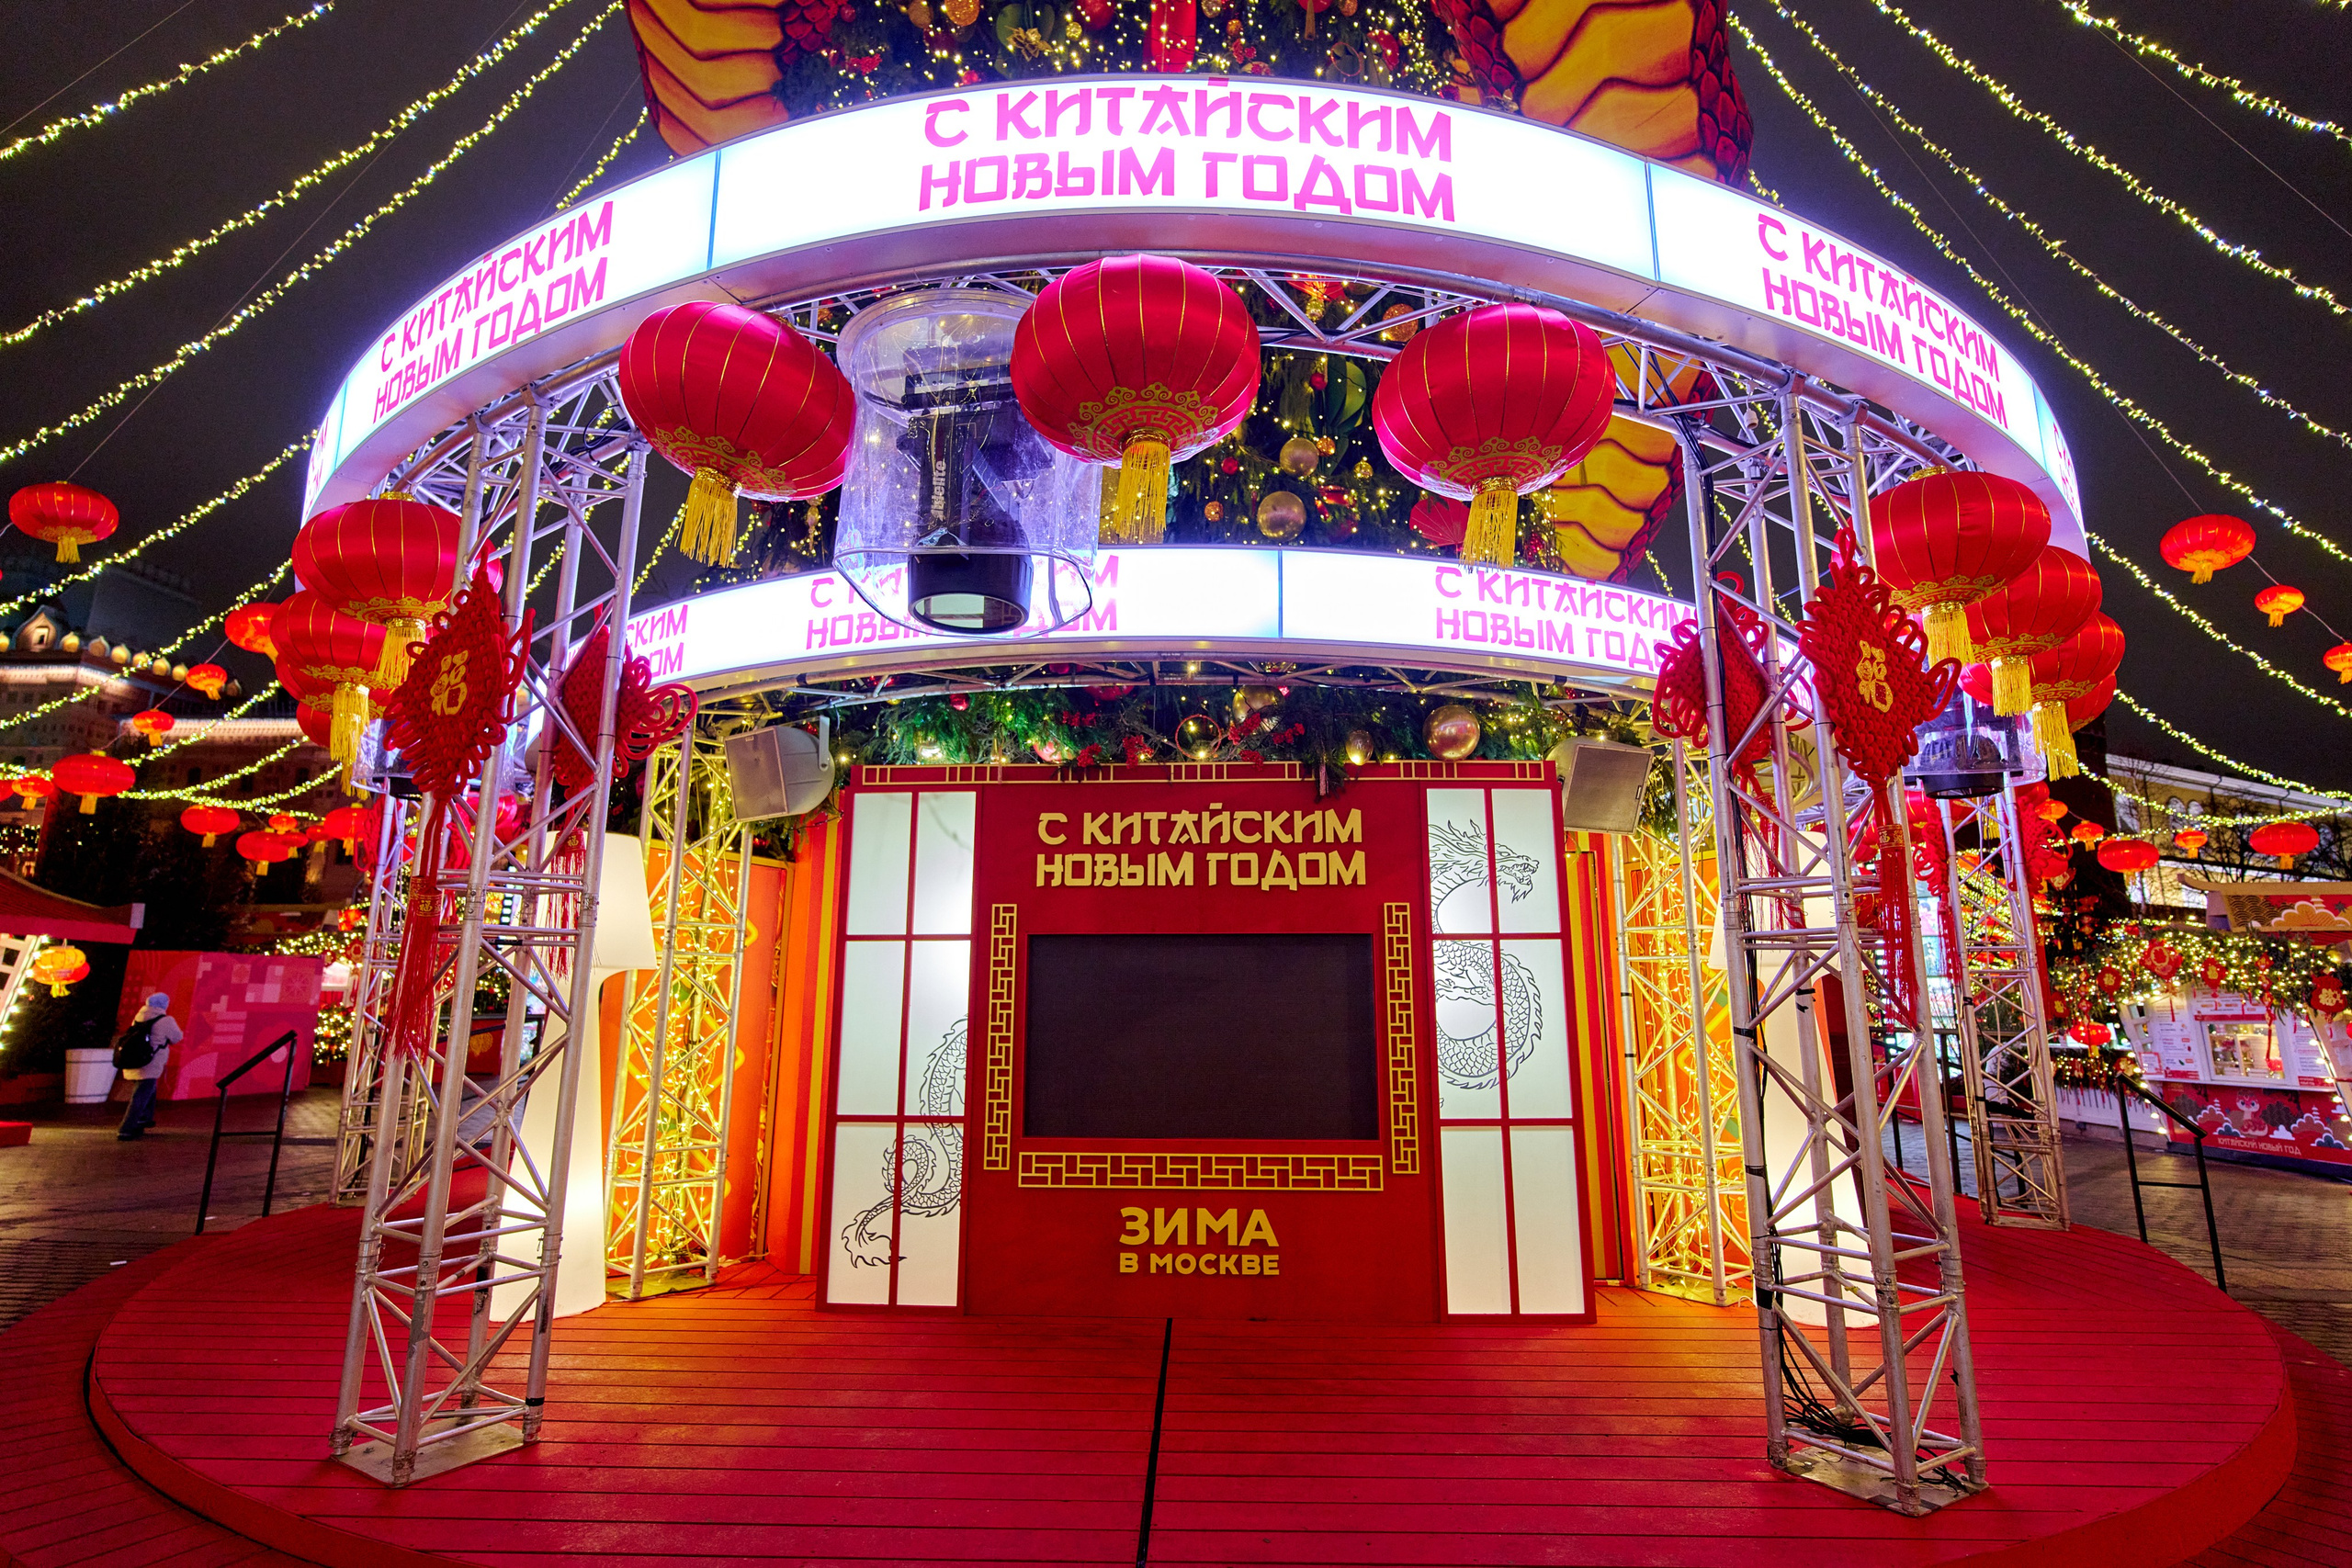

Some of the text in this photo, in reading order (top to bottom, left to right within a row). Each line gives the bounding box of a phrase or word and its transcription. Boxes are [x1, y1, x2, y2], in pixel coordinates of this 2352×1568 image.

[925, 77, 1452, 163] С КИТАЙСКИМ
[919, 146, 1454, 222] НОВЫМ ГОДОМ
[380, 201, 613, 372] С КИТАЙСКИМ
[1758, 213, 2000, 382] С КИТАЙСКИМ
[373, 257, 608, 423] НОВЫМ ГОДОМ
[1762, 267, 2008, 429] НОВЫМ ГОДОМ
[811, 578, 834, 608] С
[1435, 566, 1462, 598] С
[806, 612, 937, 649] НОВЫ
[1436, 607, 1574, 655] НОВЫМ
[1037, 803, 1363, 845] С КИТАЙСКИМ
[1036, 849, 1366, 891] НОВЫМ ГОДОМ
[2218, 1137, 2302, 1156] КИТАЙСКИЙ НОВЫЙ ГОД
[1119, 1206, 1279, 1247] ЗИМА
[1119, 1252, 1280, 1276] В МОСКВЕ
